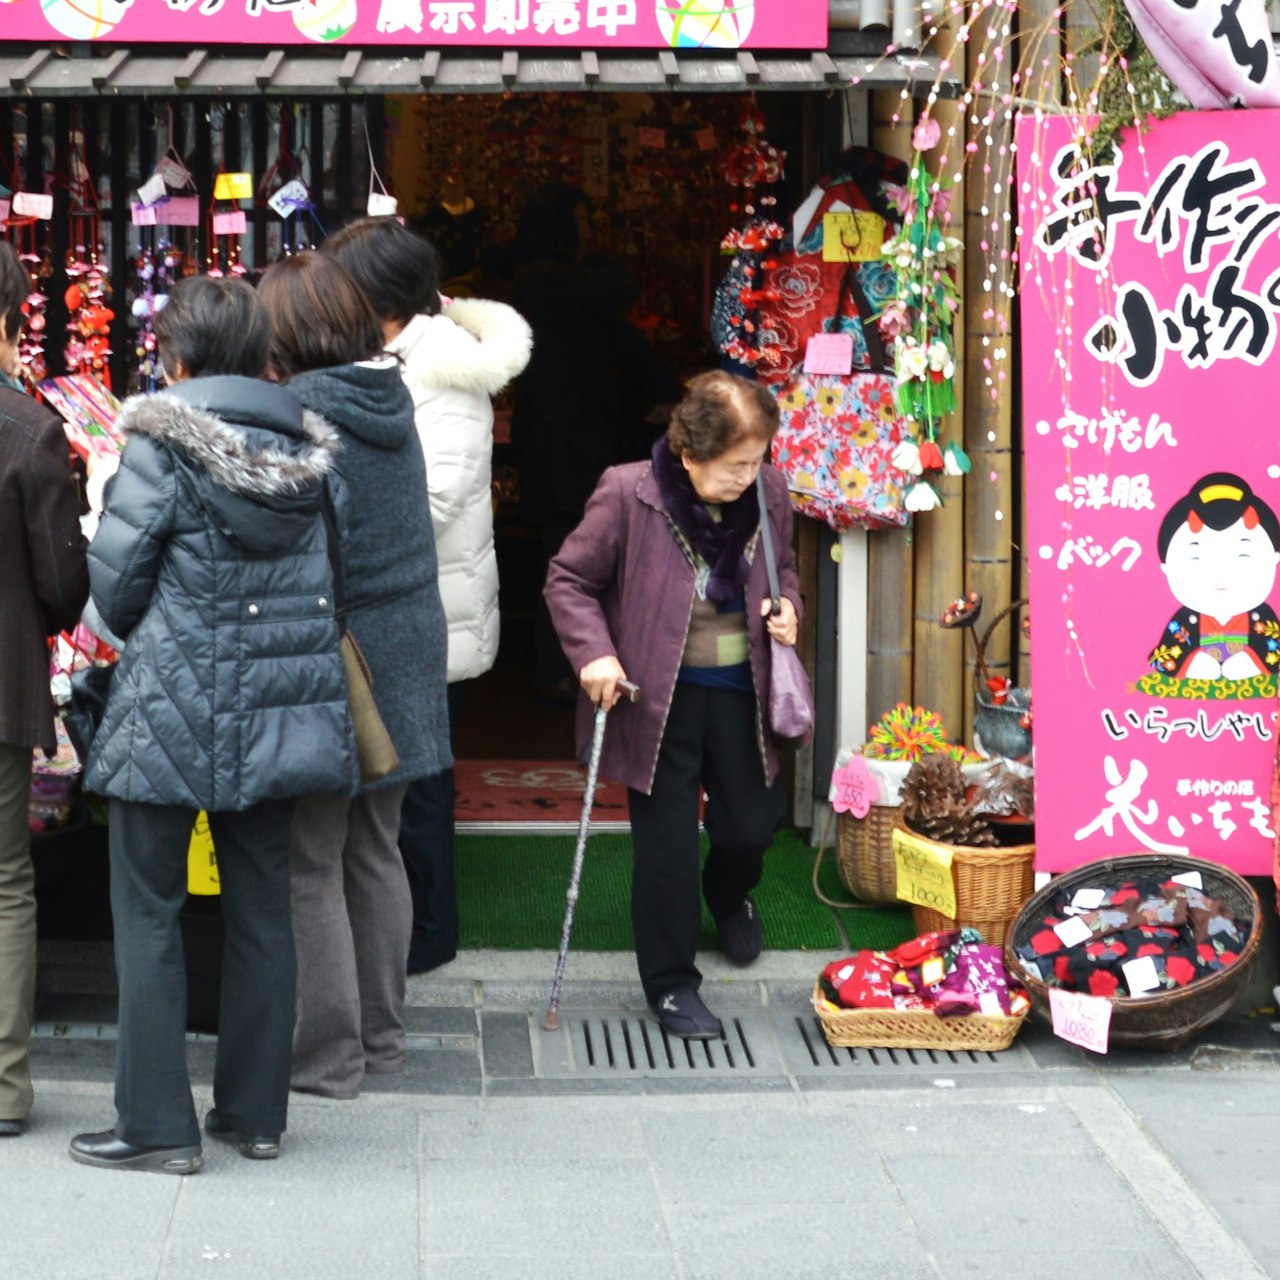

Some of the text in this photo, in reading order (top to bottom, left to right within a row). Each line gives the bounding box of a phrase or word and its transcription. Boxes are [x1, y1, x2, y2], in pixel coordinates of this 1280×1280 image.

[1057, 409, 1177, 449] さげもん
[1071, 474, 1156, 511] 洋服
